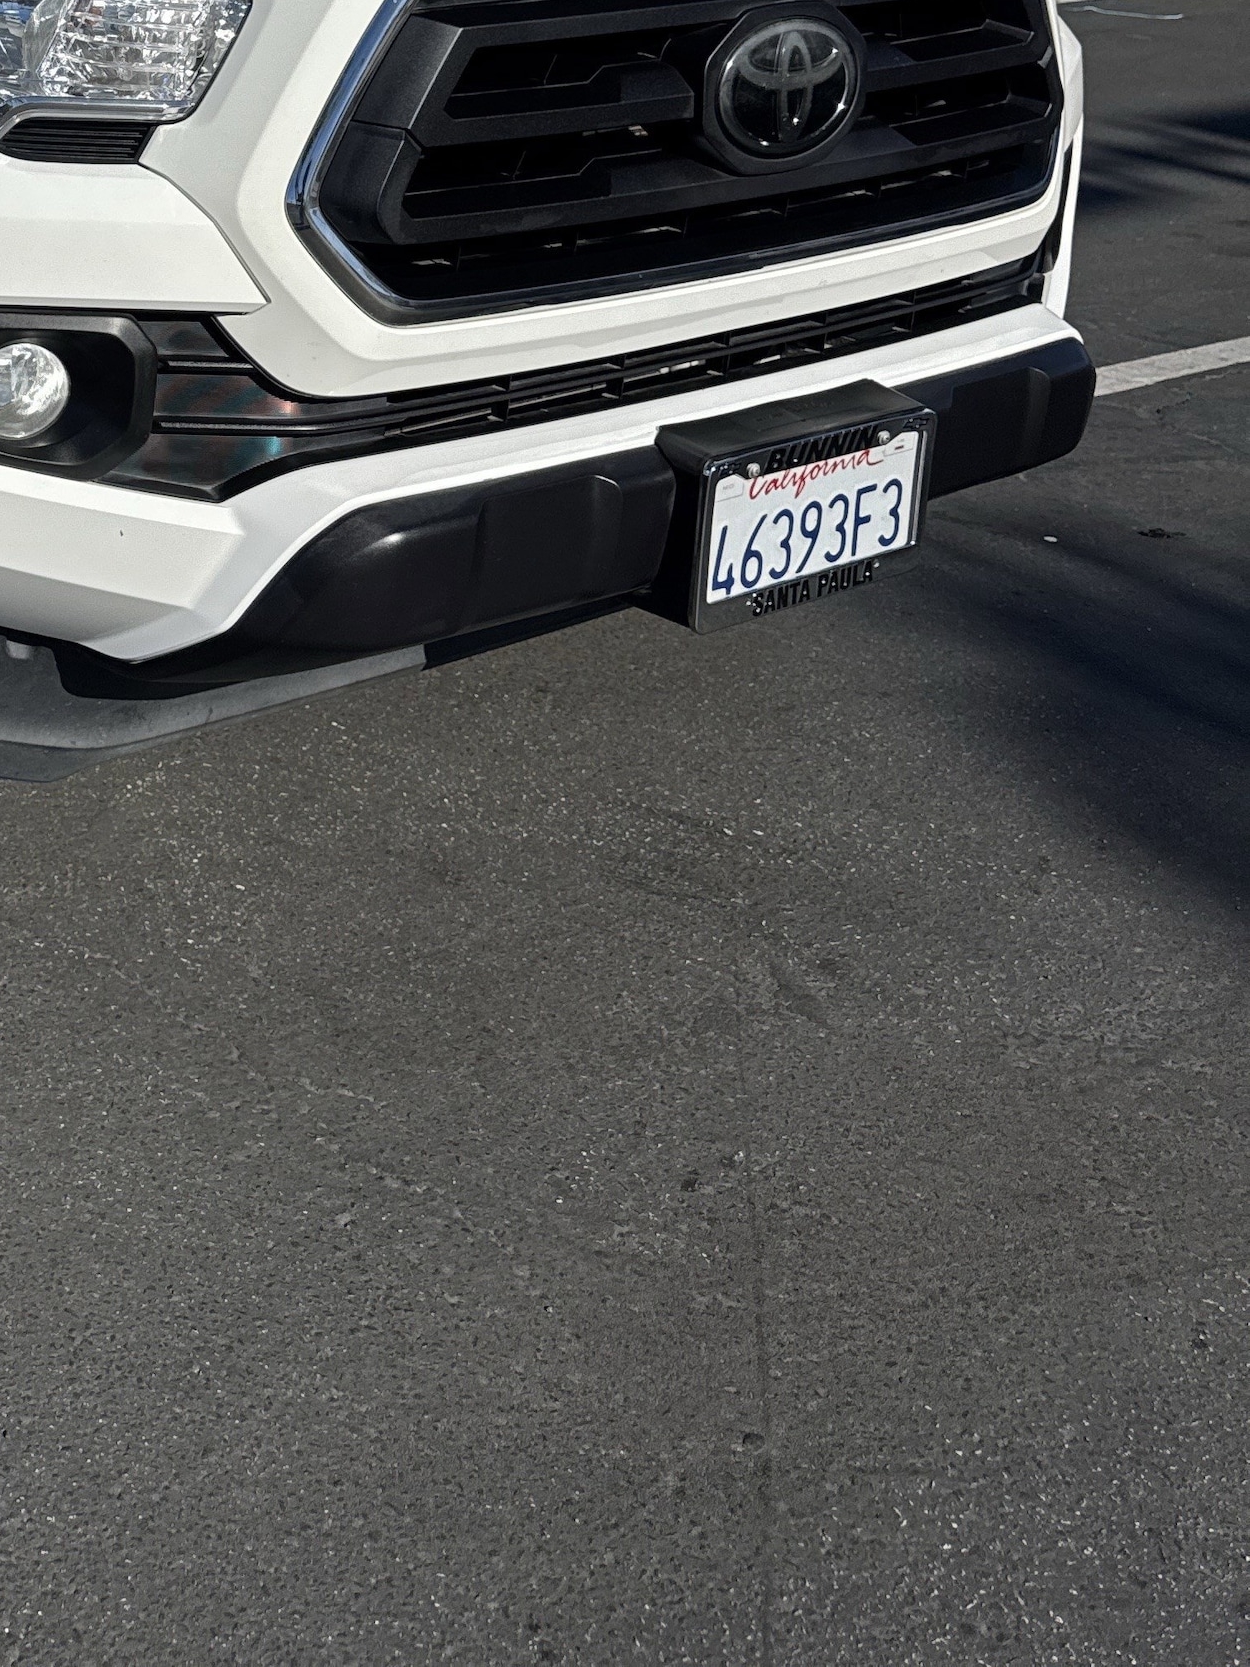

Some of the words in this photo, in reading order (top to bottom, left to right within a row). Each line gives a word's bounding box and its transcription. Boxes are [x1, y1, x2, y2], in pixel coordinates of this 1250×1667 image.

[763, 424, 879, 472] BUNNIN
[710, 477, 904, 596] 46393F3
[751, 580, 812, 618] SANTA
[816, 560, 874, 598] PAULA
